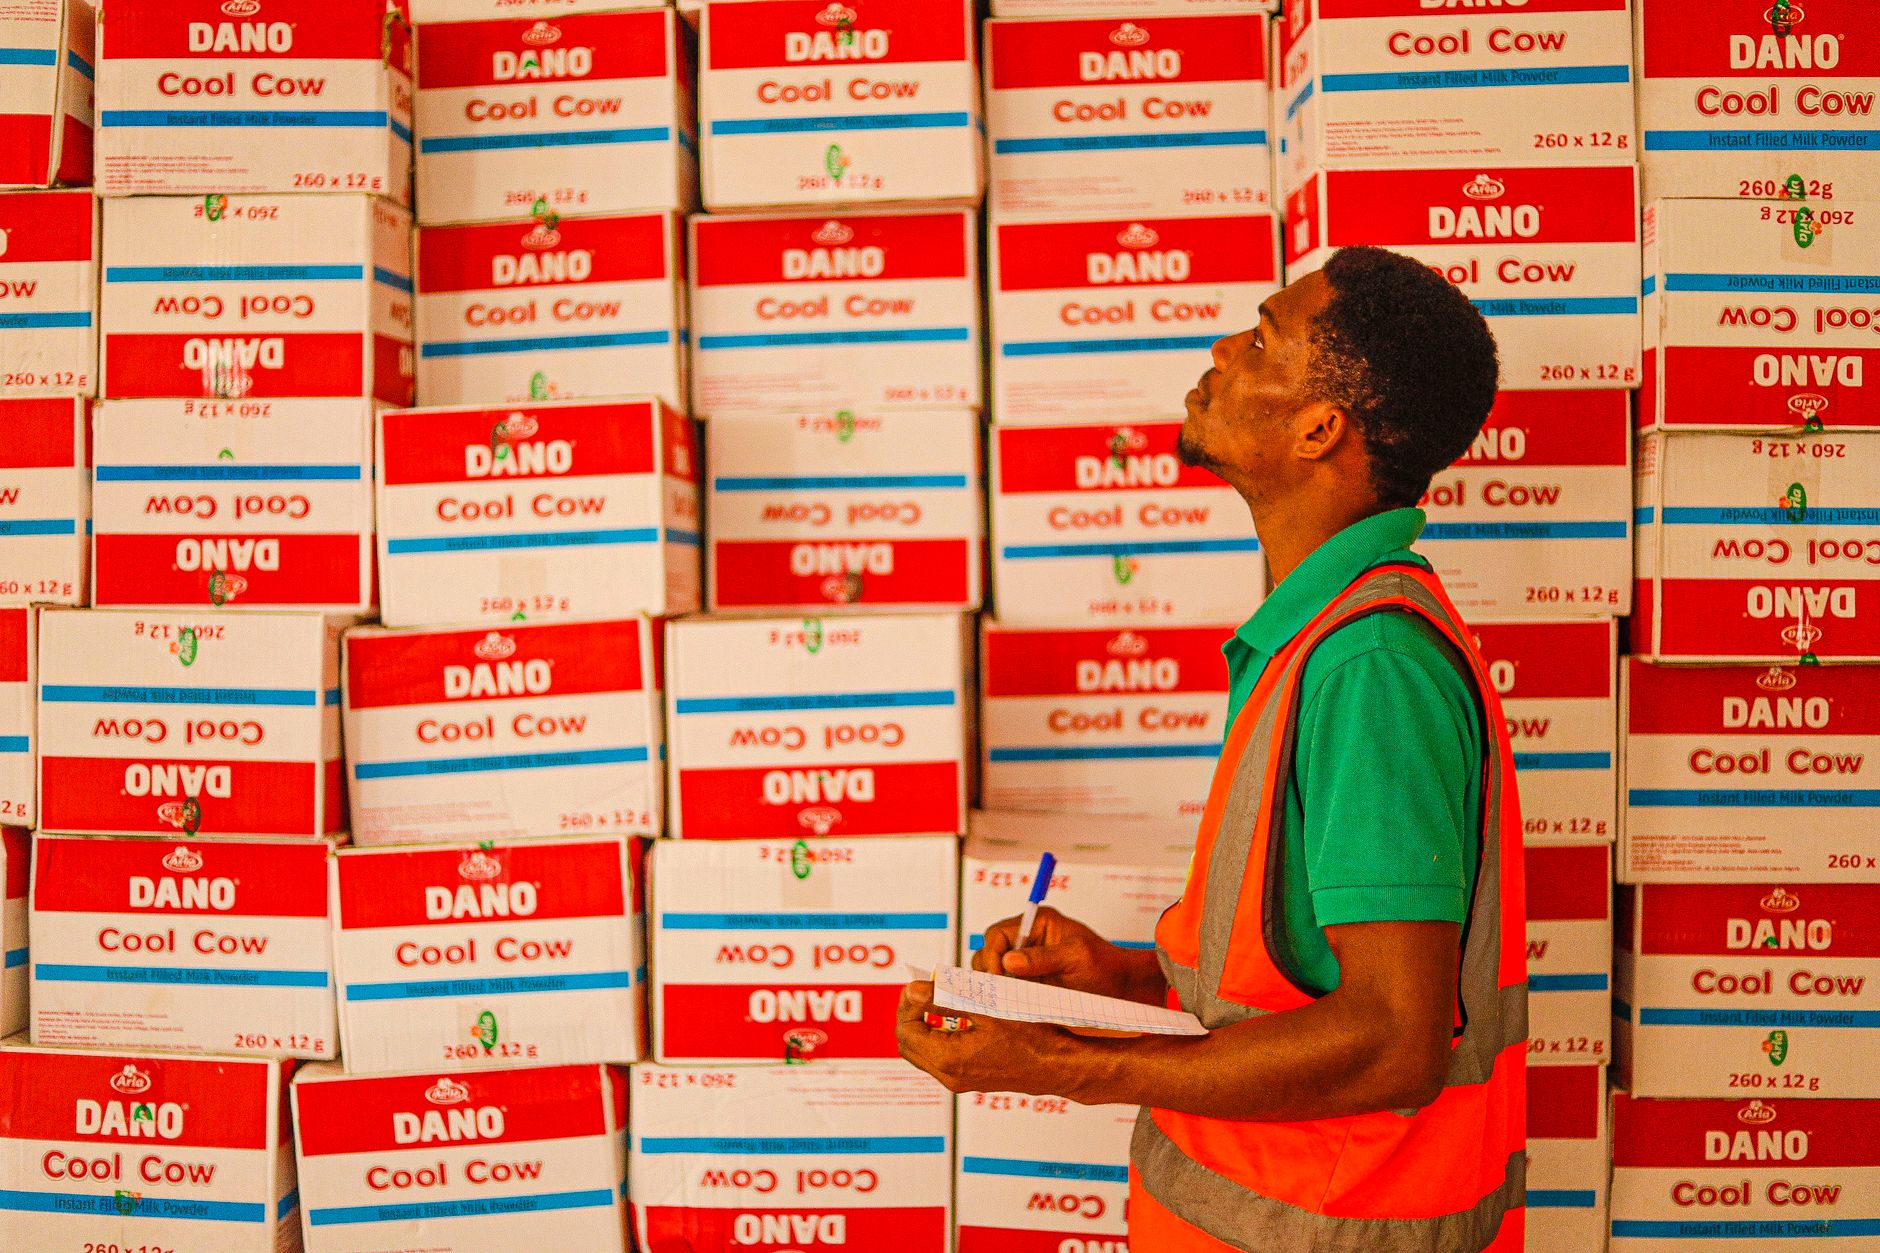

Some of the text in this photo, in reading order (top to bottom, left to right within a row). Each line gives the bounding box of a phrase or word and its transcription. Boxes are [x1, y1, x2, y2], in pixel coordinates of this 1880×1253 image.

[189, 22, 292, 52] DANO
[786, 30, 888, 61] DANO
[1388, 29, 1565, 56] Cool Cow
[1080, 49, 1180, 80] DANO
[1730, 34, 1839, 69] DANO
[158, 73, 324, 96] Cool Cow
[1397, 69, 1558, 85] Instant Filled Milk Powder
[757, 78, 919, 104] Cool Cow
[1697, 87, 1873, 115] Cool Cow
[464, 95, 621, 123] Cool Cow
[1052, 97, 1212, 123] Cool Cow
[1535, 134, 1568, 148] 260
[1591, 132, 1611, 146] 12
[1617, 135, 1628, 149] g
[1709, 133, 1868, 147] Instant Filled Milk Powder
[294, 174, 325, 187] 260
[347, 173, 366, 188] 12
[371, 177, 380, 192] g
[1740, 180, 1776, 196] 260
[1429, 205, 1539, 238] DANO
[1761, 207, 1853, 225] 260 g
[493, 250, 591, 284] DANO
[783, 247, 884, 278] DANO
[1088, 250, 1189, 283] DANO
[1498, 260, 1574, 283] Cow
[1728, 278, 1840, 290] Filled Milk Powder
[154, 295, 315, 319] Cool Cow
[464, 299, 620, 327] Cool Cow
[756, 295, 914, 320] Cool Cow
[1060, 299, 1221, 326] Cool Cow
[1720, 307, 1796, 332] Cow
[5, 373, 35, 386] 260
[56, 372, 73, 386] 12
[78, 375, 87, 387] g
[1541, 365, 1575, 380] 260
[1598, 365, 1618, 379] 12
[1624, 368, 1634, 382] g
[1754, 354, 1862, 386] DANO
[1752, 440, 1762, 454] g
[1768, 443, 1789, 458] 12
[1812, 444, 1845, 458] 260
[1482, 481, 1560, 506] Cow
[146, 495, 310, 519] Cool Cow
[436, 494, 605, 522] Cool Cow
[760, 502, 922, 526] Cool Cow
[1048, 504, 1209, 530] Cool Cow
[177, 539, 279, 571] DANO
[792, 544, 892, 575] DANO
[1713, 539, 1790, 564] Cow
[1526, 587, 1559, 602] 260
[1583, 586, 1602, 601] 12
[1608, 590, 1618, 604] g
[1748, 586, 1856, 618] DANO
[445, 660, 551, 698] DANO
[1078, 659, 1178, 690] DANO
[1046, 707, 1208, 735] Cool Cow
[1724, 697, 1829, 728] DANO
[94, 719, 264, 745] Cool Cow
[416, 714, 586, 744] Cool Cow
[731, 723, 905, 751] Cool Cow
[1690, 749, 1862, 774] Cool Cow
[125, 764, 231, 797] DANO
[764, 769, 874, 804] DANO
[1828, 855, 1861, 868] 260
[130, 877, 235, 909] DANO
[426, 882, 536, 919] DANO
[98, 928, 267, 954] Cool Cow
[1727, 919, 1831, 950] DANO
[396, 937, 572, 967] Cool Cow
[717, 944, 895, 969] Cool Cow
[1692, 969, 1863, 995] Cool Cow
[750, 990, 861, 1022] DANO
[1700, 1011, 1853, 1024] Instant Filled Milk Powder
[235, 1034, 267, 1048] 260
[290, 1035, 309, 1049] 12
[314, 1040, 324, 1053] g
[1729, 1074, 1762, 1087] 260
[1783, 1074, 1804, 1088] 12
[1809, 1078, 1819, 1091] g
[393, 1107, 504, 1143] DANO
[1706, 1130, 1807, 1160] DANO
[43, 1151, 214, 1183] Cool Cow
[366, 1160, 542, 1190] Cool Cow
[701, 1169, 878, 1193] Cool Cow
[1672, 1181, 1840, 1206] Cool Cow
[1028, 1193, 1105, 1219] Cow
[735, 1214, 845, 1244] DANO
